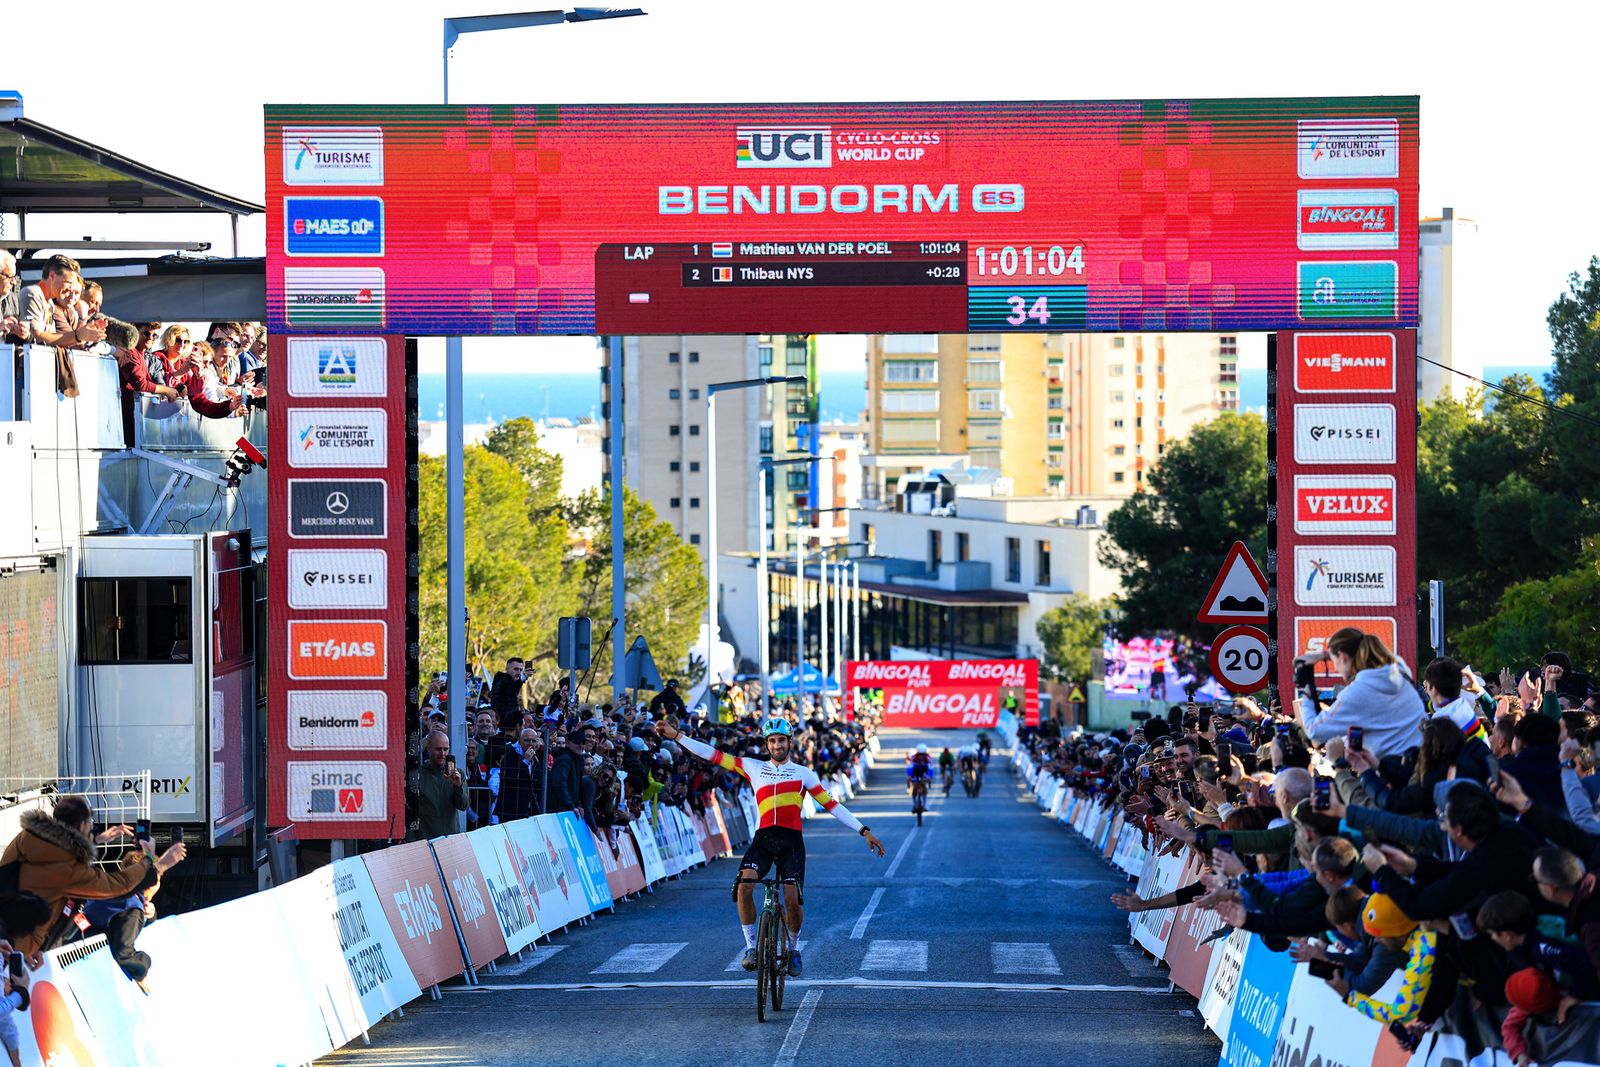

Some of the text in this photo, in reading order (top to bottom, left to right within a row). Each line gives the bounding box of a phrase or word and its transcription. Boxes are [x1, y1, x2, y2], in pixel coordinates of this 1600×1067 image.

[836, 131, 940, 145] CYCLO-CROSS
[752, 133, 823, 161] UCI
[1329, 149, 1342, 158] DE
[315, 152, 371, 163] TURISME
[837, 147, 925, 161] WORLD CUP
[658, 184, 959, 214] BENIDORM
[305, 218, 350, 235] MAES
[624, 245, 655, 260] LAP
[692, 242, 961, 255] 1 Mathieu VAN DER POEL 1:01:04
[975, 245, 1085, 276] 1:01:04
[692, 267, 961, 280] 2 Thibau NYS +0:28
[1006, 295, 1051, 327] 34
[315, 430, 369, 439] COMUNITAT
[1328, 428, 1380, 439] PISSEI
[320, 439, 375, 448] DE L'ESPORT
[1306, 495, 1385, 514] VELUX
[356, 517, 374, 526] VANS
[321, 573, 372, 584] PISSEI
[1327, 572, 1385, 584] TURISME
[1224, 648, 1264, 672] 20
[907, 677, 1026, 687] FUN FUN
[299, 716, 359, 728] Benidorm
[962, 711, 996, 725] FUN
[312, 769, 364, 786] simac
